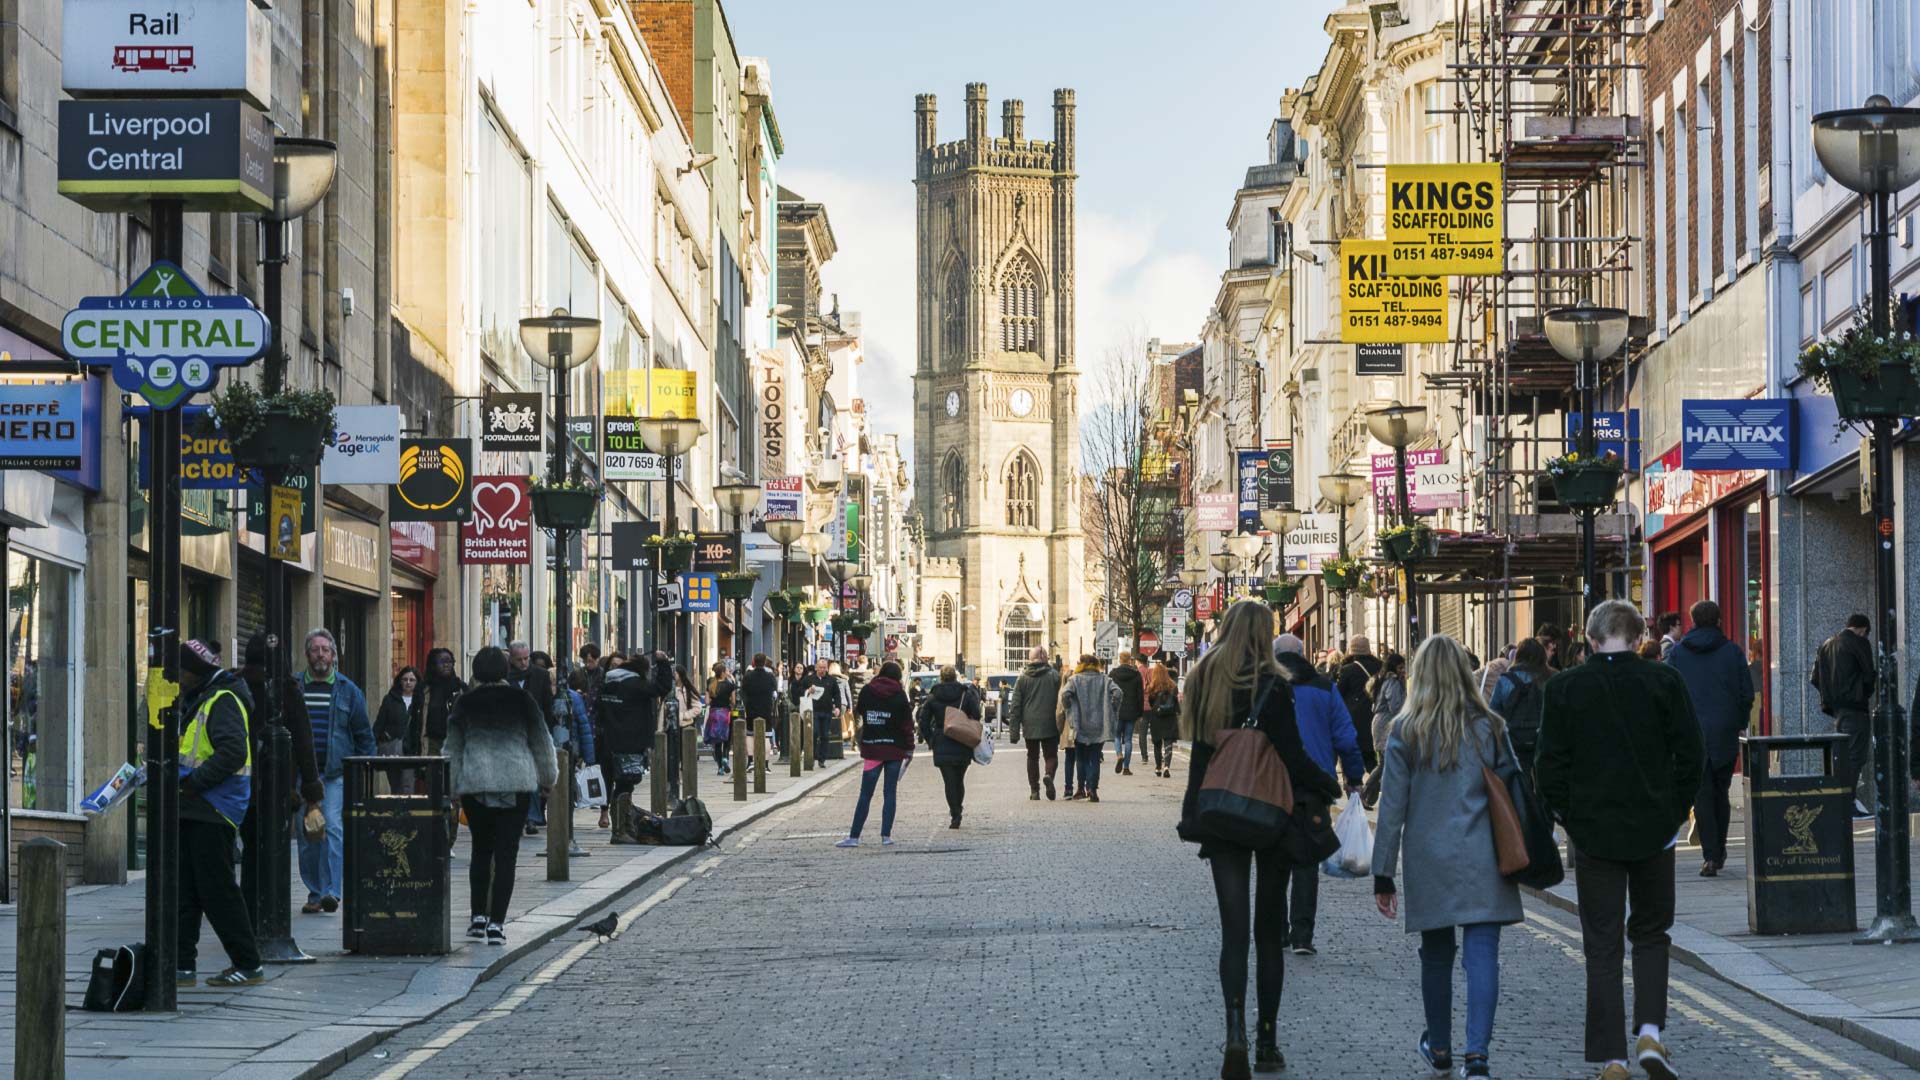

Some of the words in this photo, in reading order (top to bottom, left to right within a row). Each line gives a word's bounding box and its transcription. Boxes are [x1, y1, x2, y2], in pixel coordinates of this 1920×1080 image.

[129, 13, 179, 35] Rail
[88, 112, 211, 140] Liverpool
[87, 147, 183, 171] Central
[1392, 182, 1494, 210] KINGS
[1392, 212, 1494, 229] SCAFFOLDING
[1428, 233, 1458, 245] TEL.
[1393, 248, 1425, 260] 0151
[1431, 247, 1493, 260] 487-9494
[108, 300, 214, 309] LIVERPOOL
[1382, 301, 1410, 313] TEL.
[1350, 315, 1379, 326] 0151
[1384, 315, 1442, 326] 487-9494
[70, 319, 255, 348] CENTRAL
[1, 400, 60, 415] CAFFÈ
[763, 367, 783, 458] LOOKS
[1593, 418, 1611, 427] HE
[355, 434, 394, 442] Merseyside
[1686, 426, 1785, 443] HALIFAX
[608, 436, 623, 449] TO
[626, 436, 644, 449] LET
[338, 442, 363, 457] age
[364, 443, 380, 453] UK
[606, 455, 626, 468] 020
[628, 456, 653, 469] 7659
[1375, 455, 1395, 468] SHO
[1418, 452, 1437, 465] LET
[1422, 472, 1467, 485] MOS
[1199, 495, 1212, 503] TO
[1215, 495, 1234, 503] LET
[1296, 519, 1319, 531] ALL
[465, 538, 496, 547] British
[499, 538, 527, 547] Heart
[1277, 532, 1338, 546] NQUIRIES
[465, 548, 527, 558] Foundation
[1798, 854, 1841, 867] Liverpool
